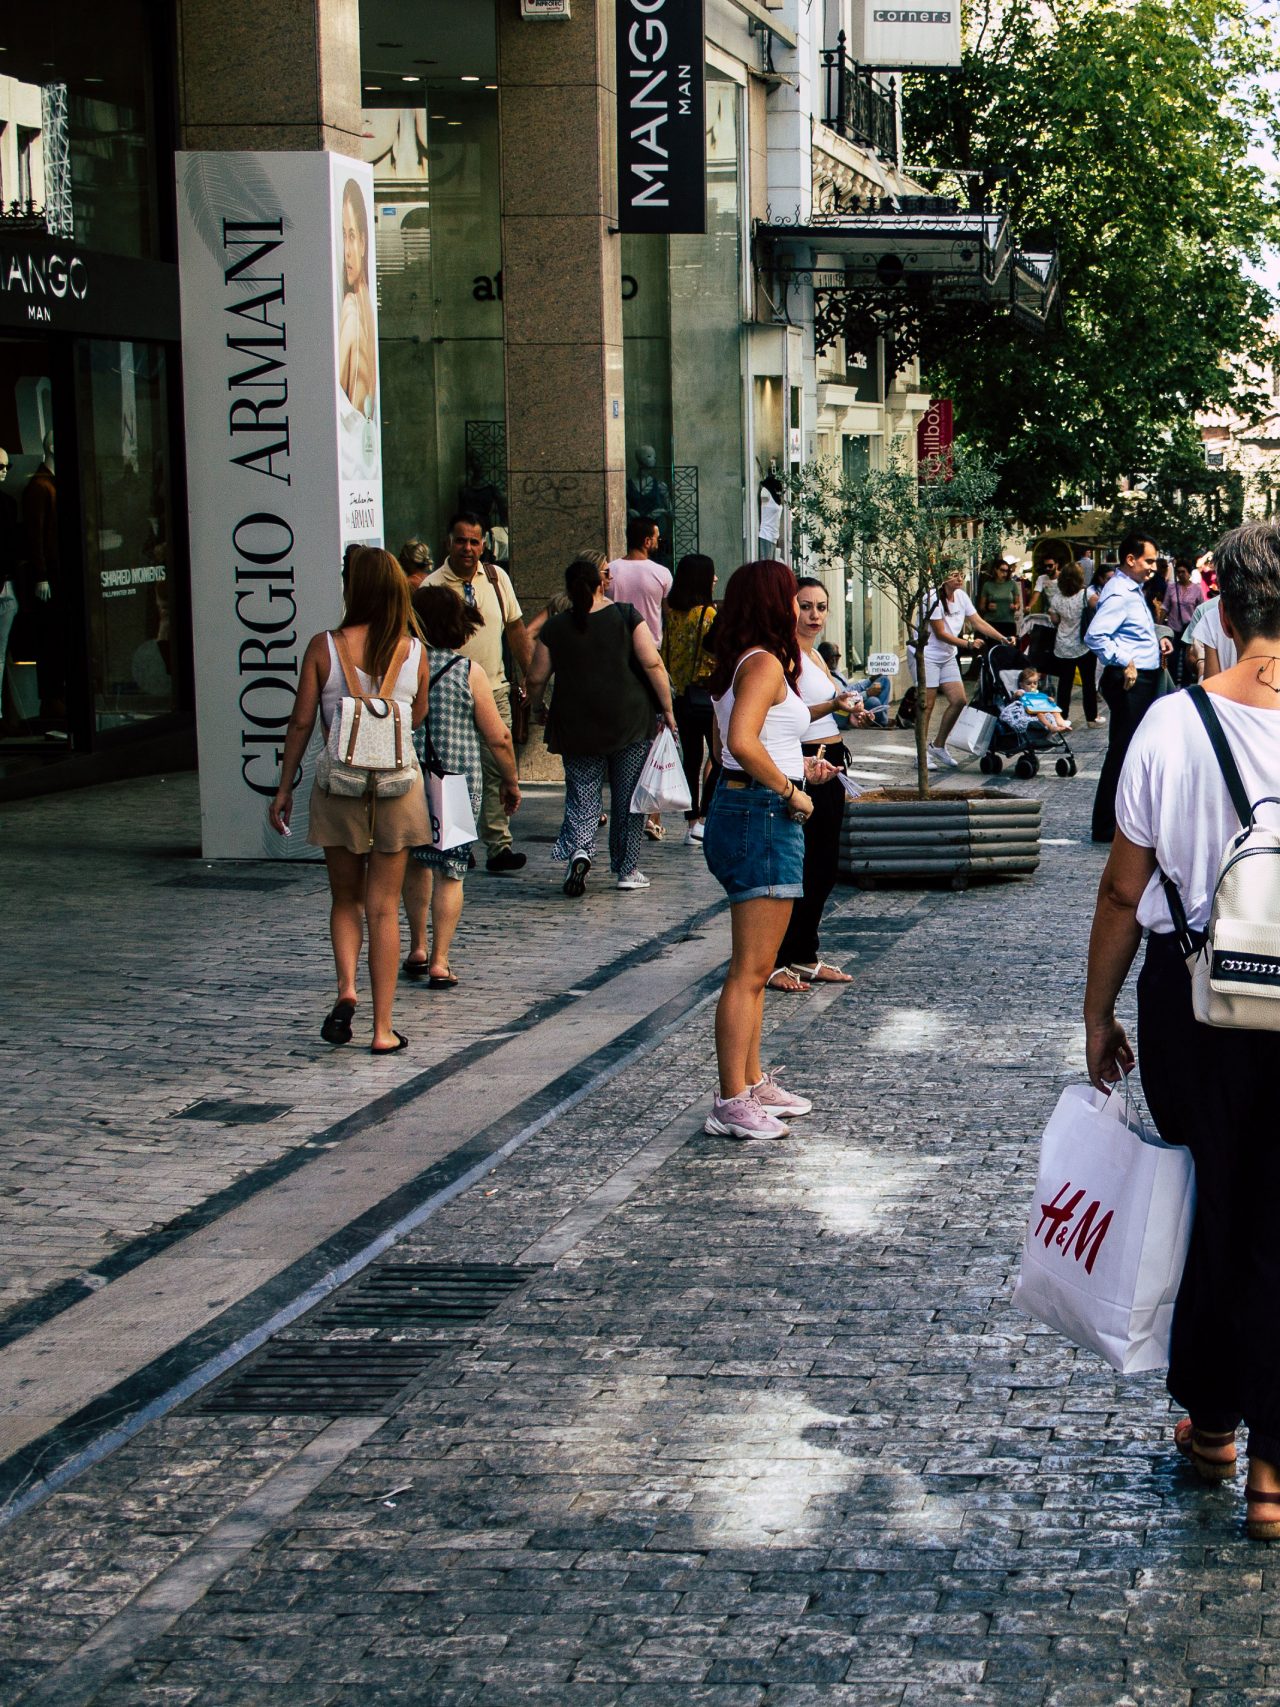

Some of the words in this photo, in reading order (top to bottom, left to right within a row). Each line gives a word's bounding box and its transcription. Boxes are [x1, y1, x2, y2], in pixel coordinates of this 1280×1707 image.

[875, 11, 949, 22] corners
[629, 0, 669, 206] MANG
[678, 65, 692, 114] MAN
[1, 254, 88, 299] ANGO
[28, 305, 51, 321] MAN
[223, 217, 292, 486] ARMANI
[231, 512, 303, 797] GIORGIO
[1034, 1181, 1114, 1275] H&M
